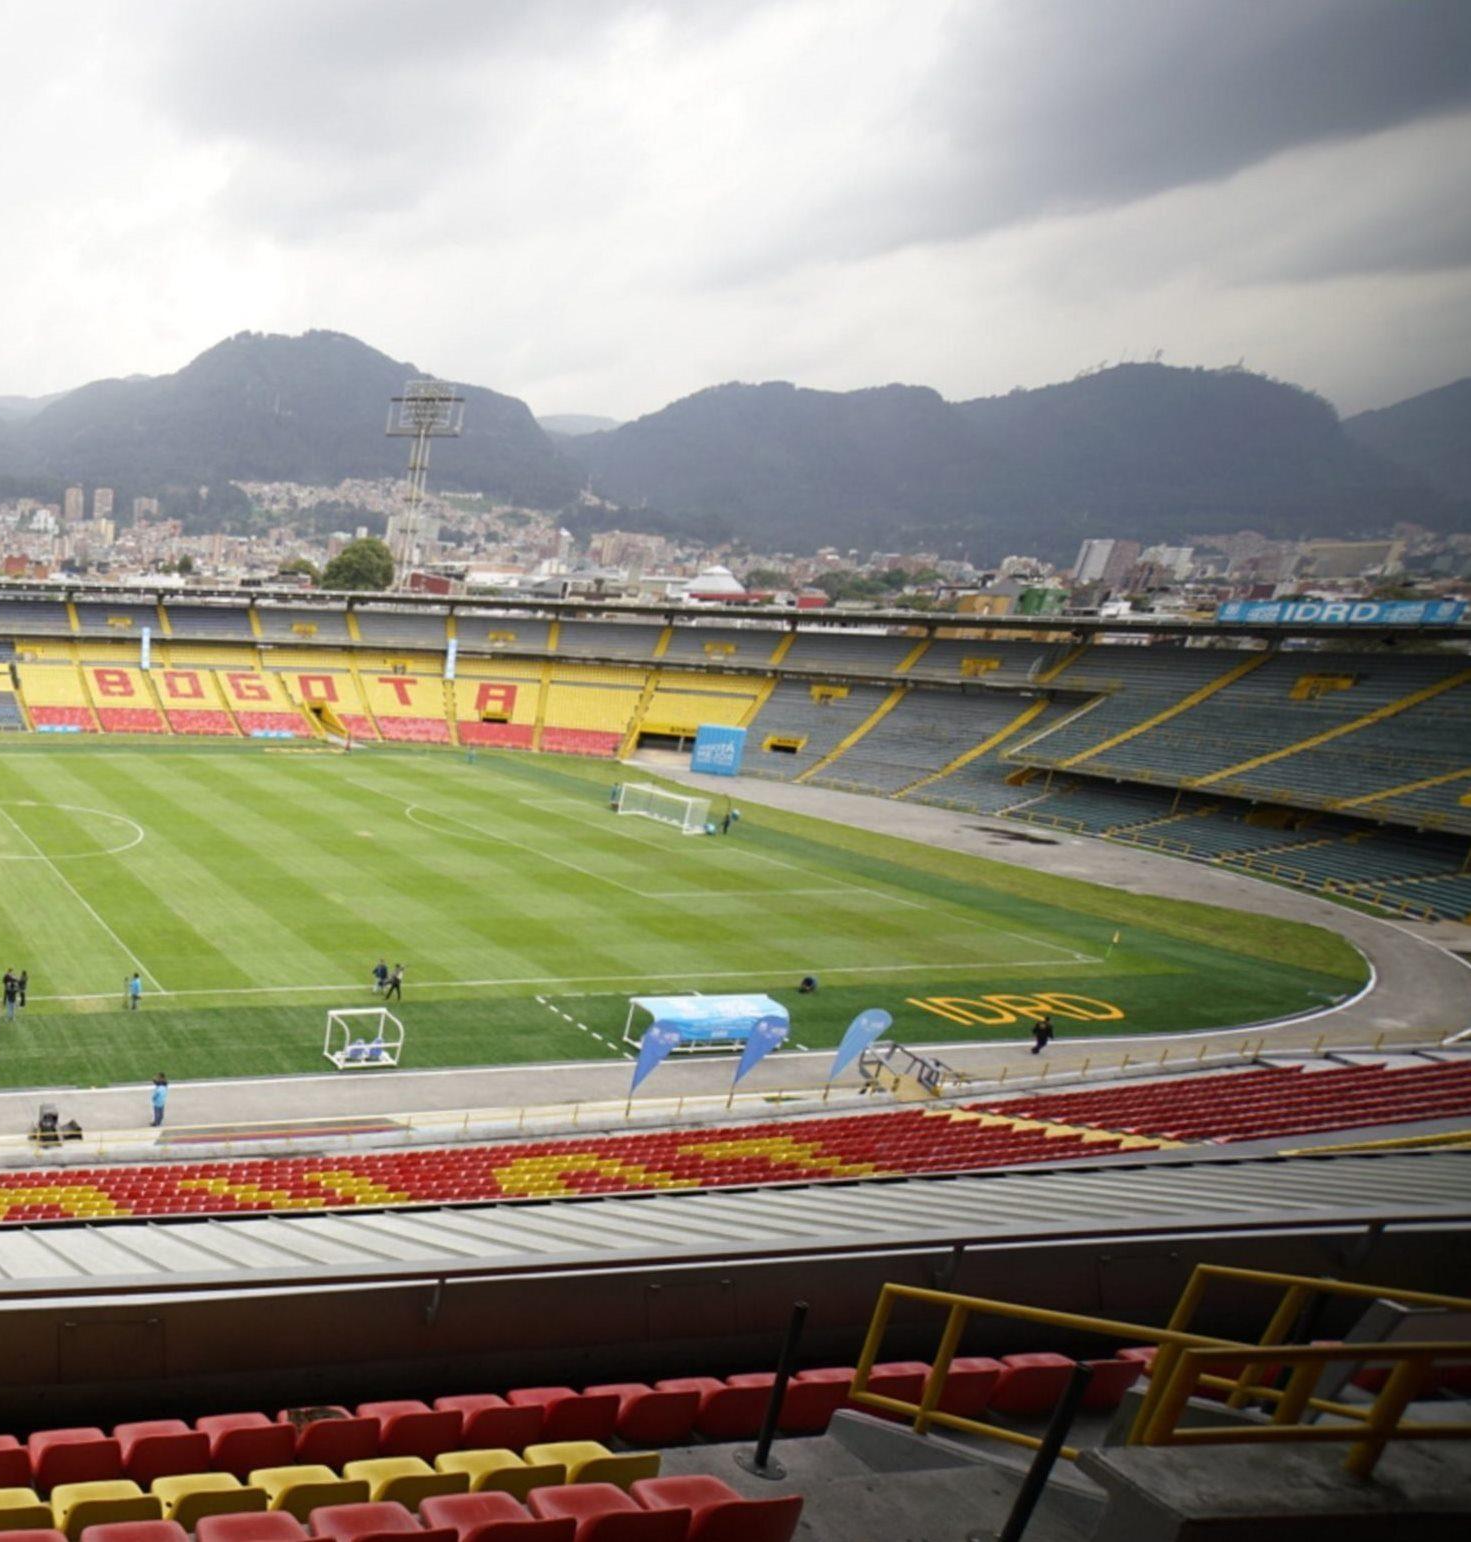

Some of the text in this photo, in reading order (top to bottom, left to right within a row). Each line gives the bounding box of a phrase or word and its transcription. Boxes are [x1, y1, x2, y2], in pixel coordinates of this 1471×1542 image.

[1283, 603, 1380, 622] IDRD
[93, 668, 519, 712] BOGOTA
[906, 992, 1125, 1026] IDRD
